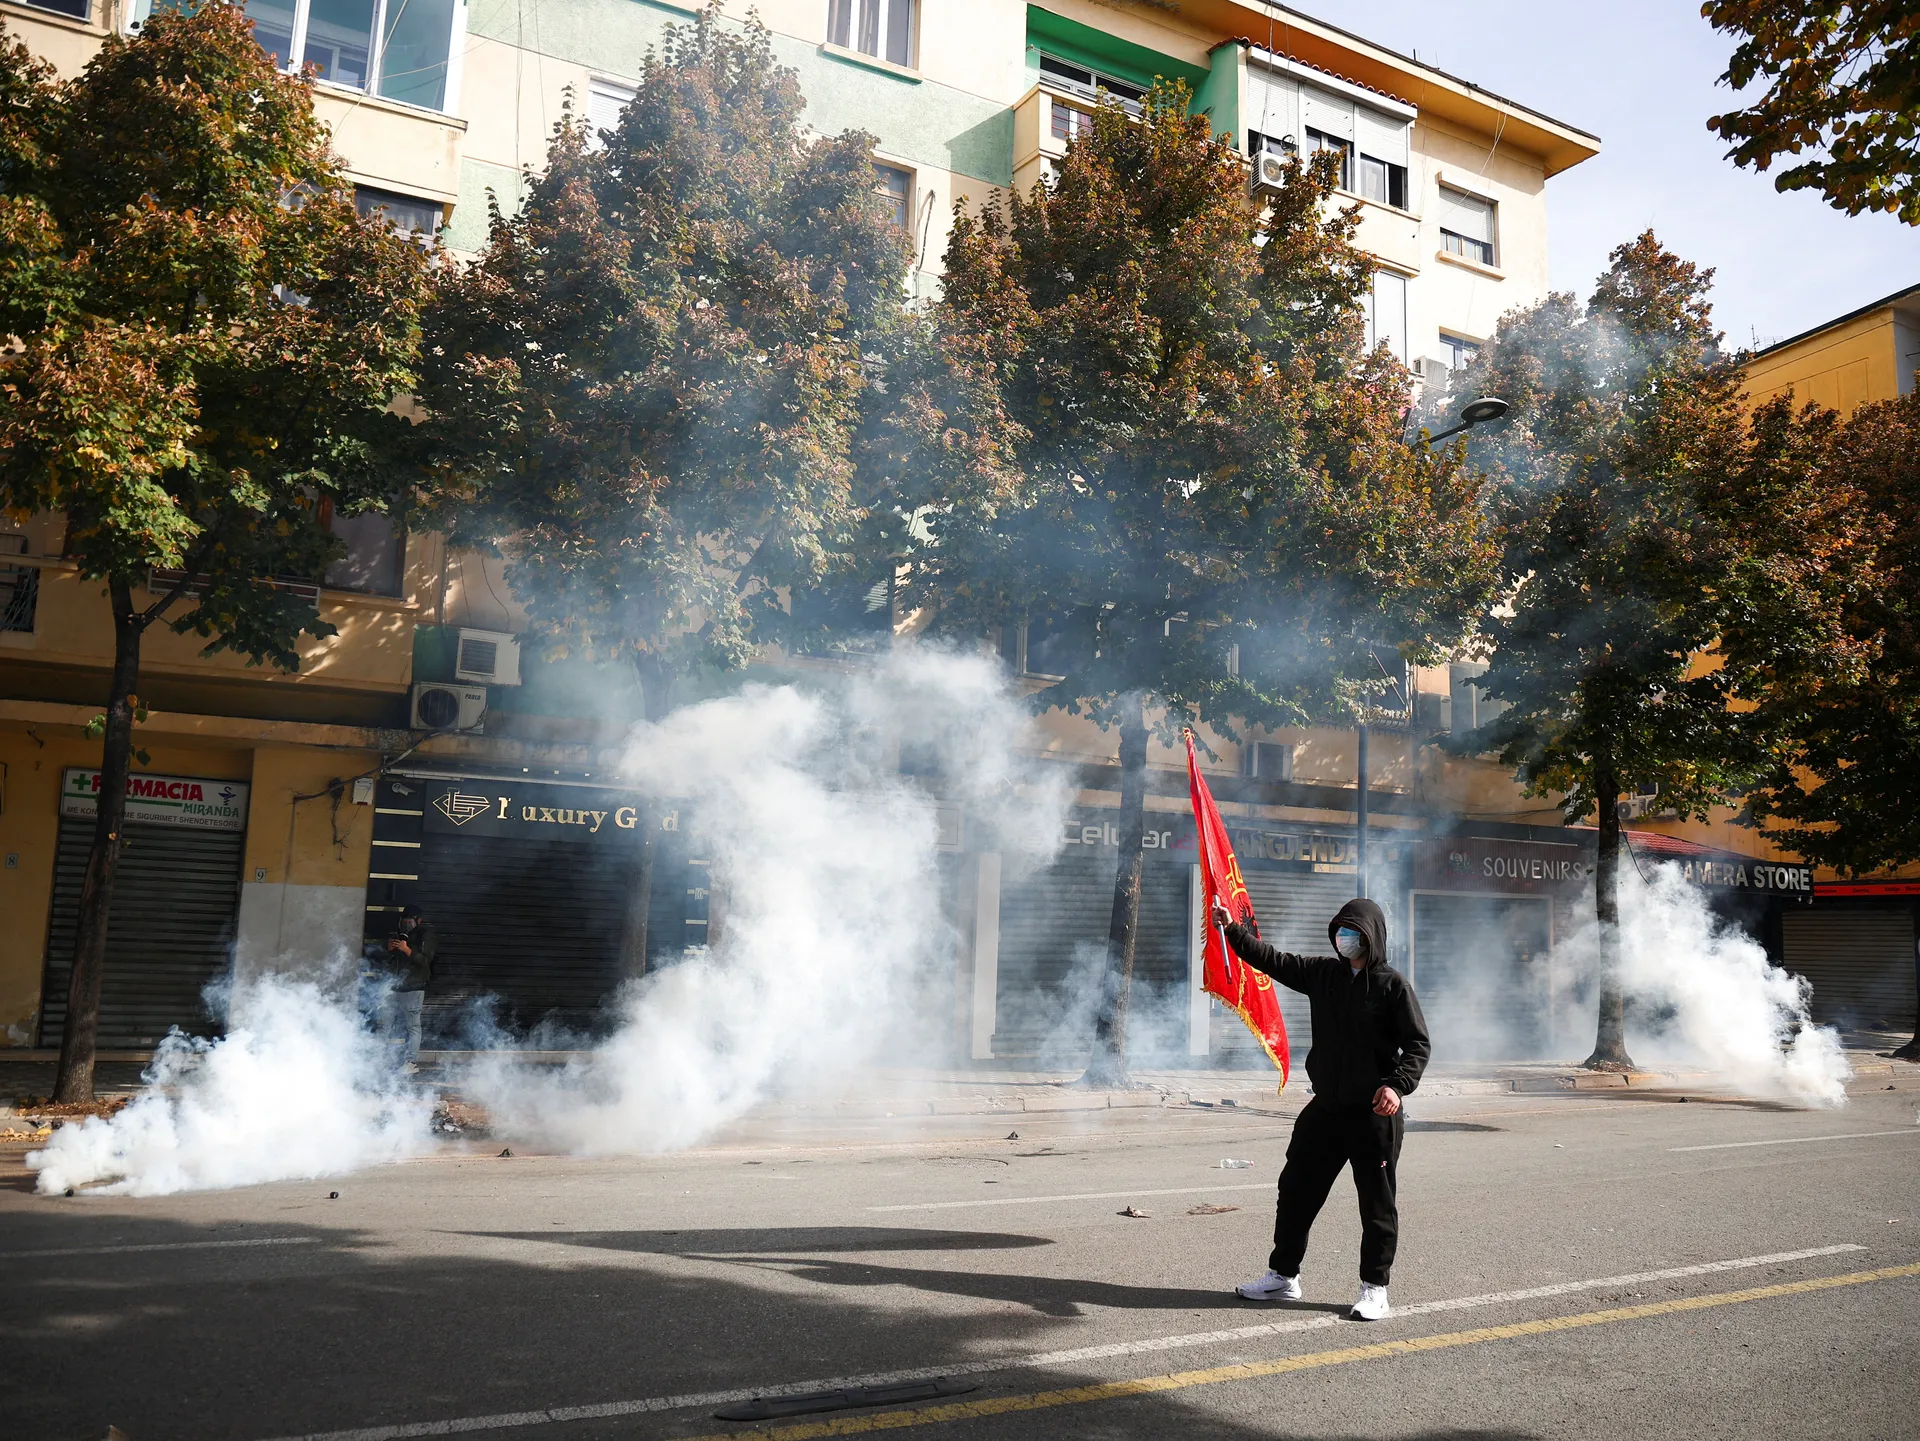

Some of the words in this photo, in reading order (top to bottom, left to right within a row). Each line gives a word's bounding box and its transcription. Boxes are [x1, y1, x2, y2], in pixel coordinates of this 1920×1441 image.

[67, 806, 79, 814] ME
[137, 813, 177, 823] SIGURIMET
[183, 804, 240, 817] MIRANDA
[8, 855, 15, 866] 8
[257, 870, 265, 881] 9
[1483, 857, 1582, 881] SOUVENIRS
[1683, 860, 1749, 888] AMERA
[1753, 866, 1811, 891] STORE
